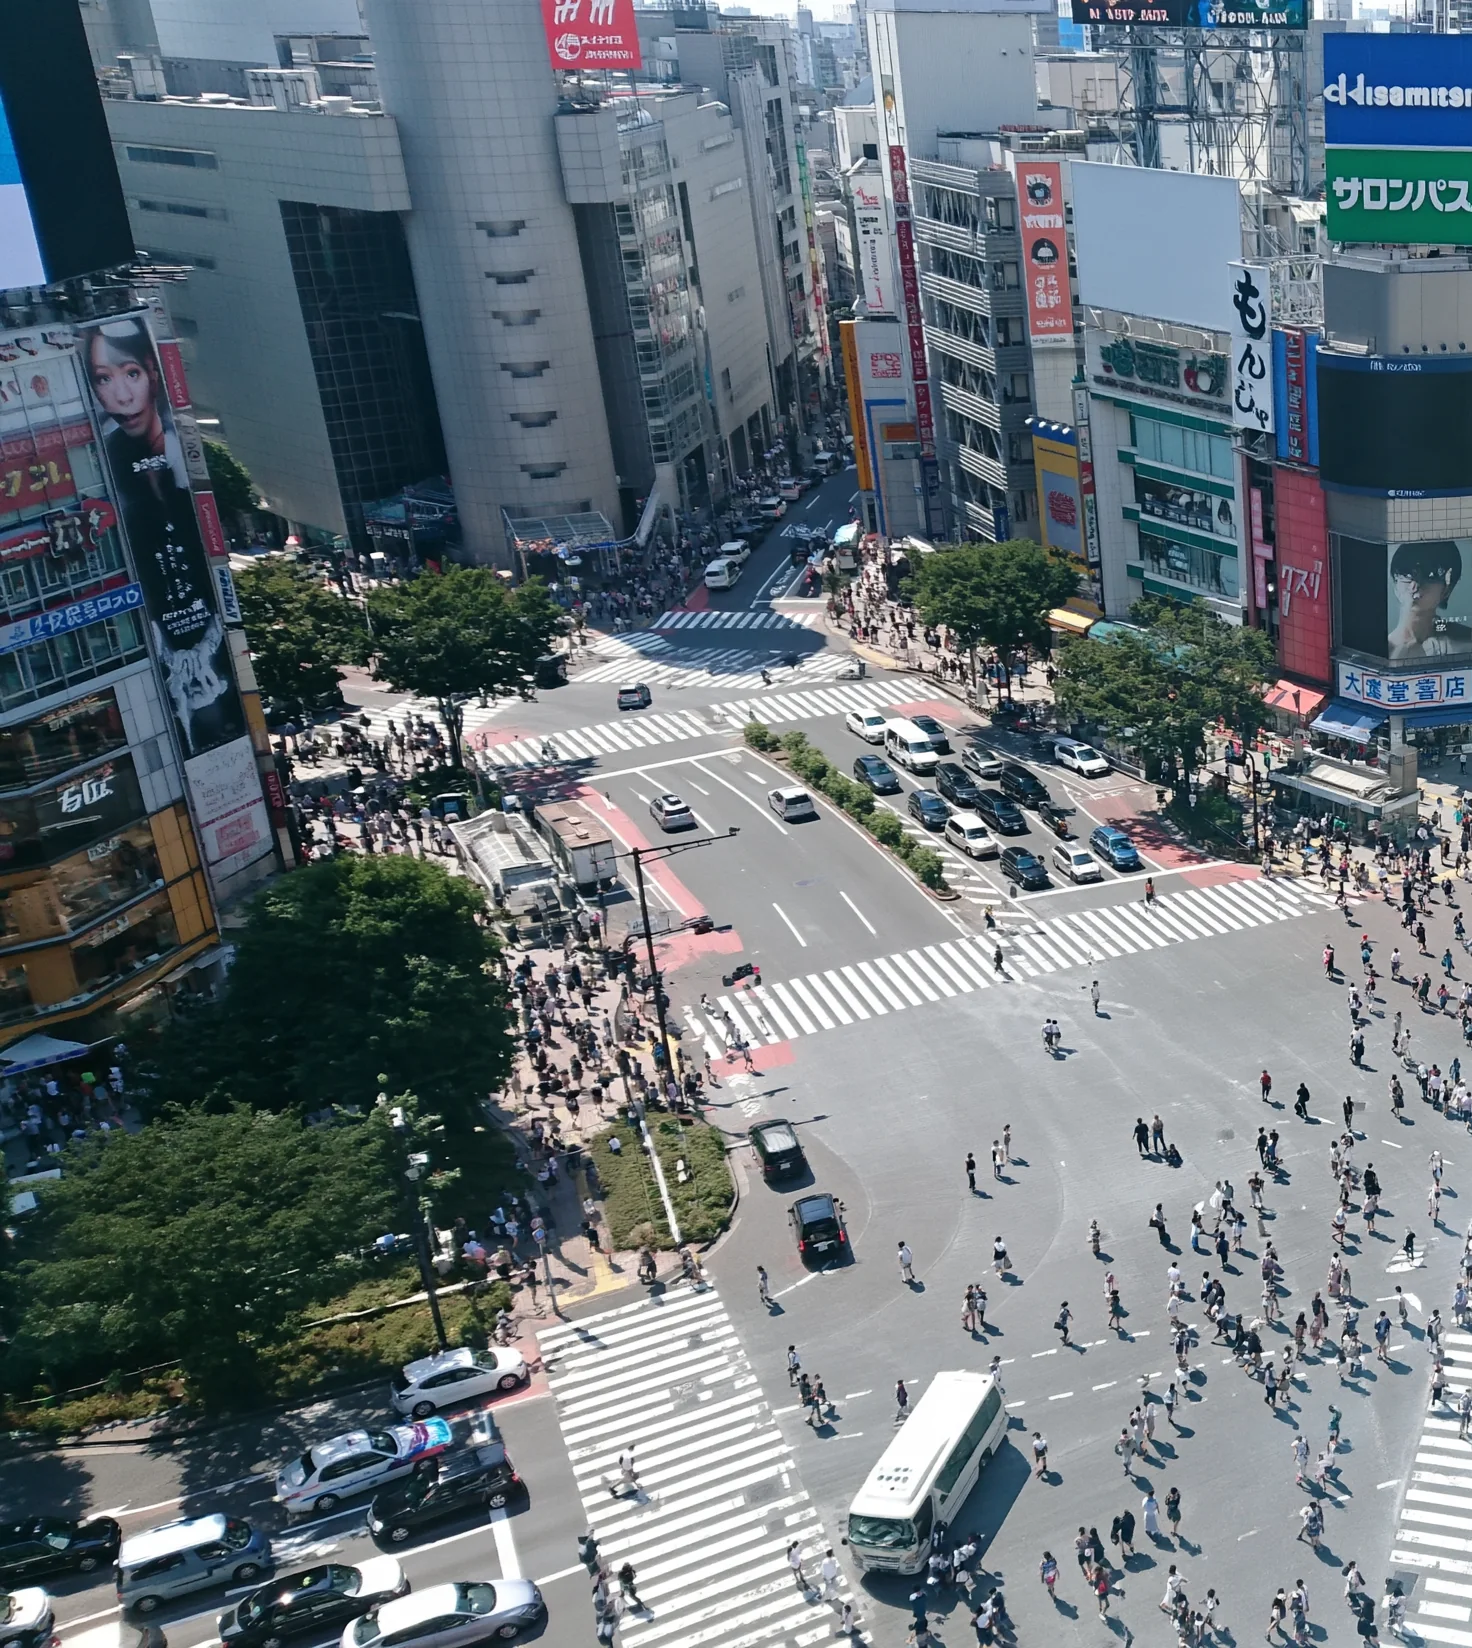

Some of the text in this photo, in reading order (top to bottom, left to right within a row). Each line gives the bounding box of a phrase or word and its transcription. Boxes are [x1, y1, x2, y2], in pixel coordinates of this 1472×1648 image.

[1332, 176, 1472, 213] サロンパス
[1234, 269, 1269, 430] もんじゃ
